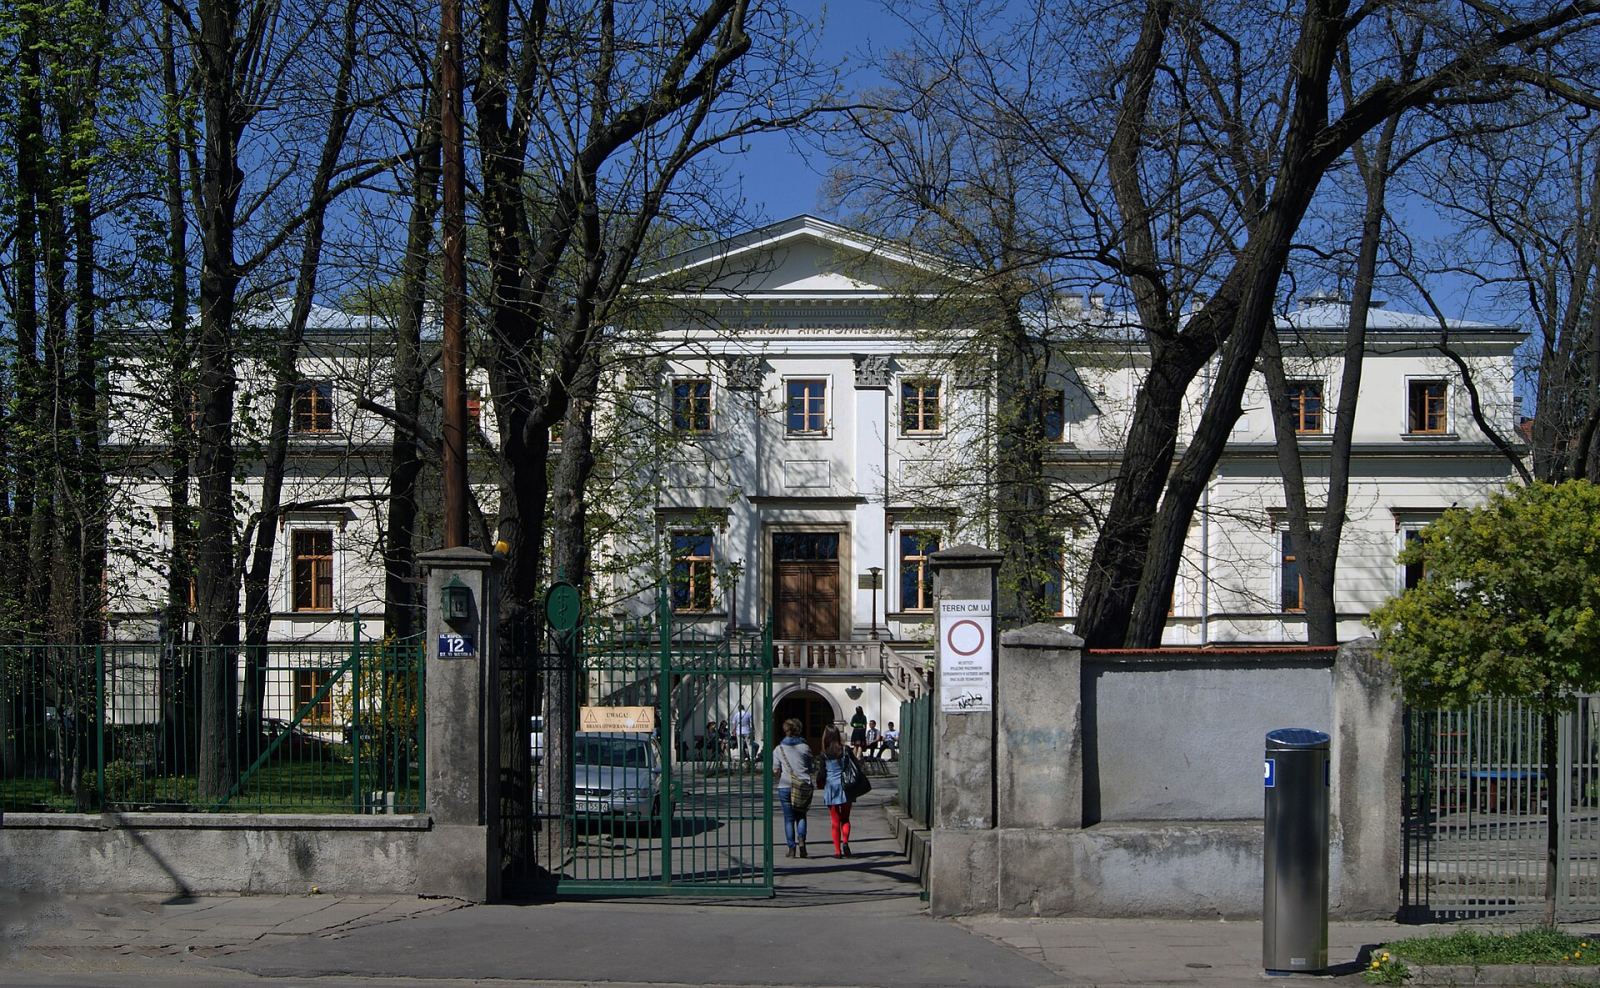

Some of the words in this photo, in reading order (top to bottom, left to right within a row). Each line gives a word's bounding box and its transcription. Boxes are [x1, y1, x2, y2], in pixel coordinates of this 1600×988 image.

[942, 604, 966, 612] TEREN
[968, 604, 979, 612] CM
[447, 638, 464, 652] 12
